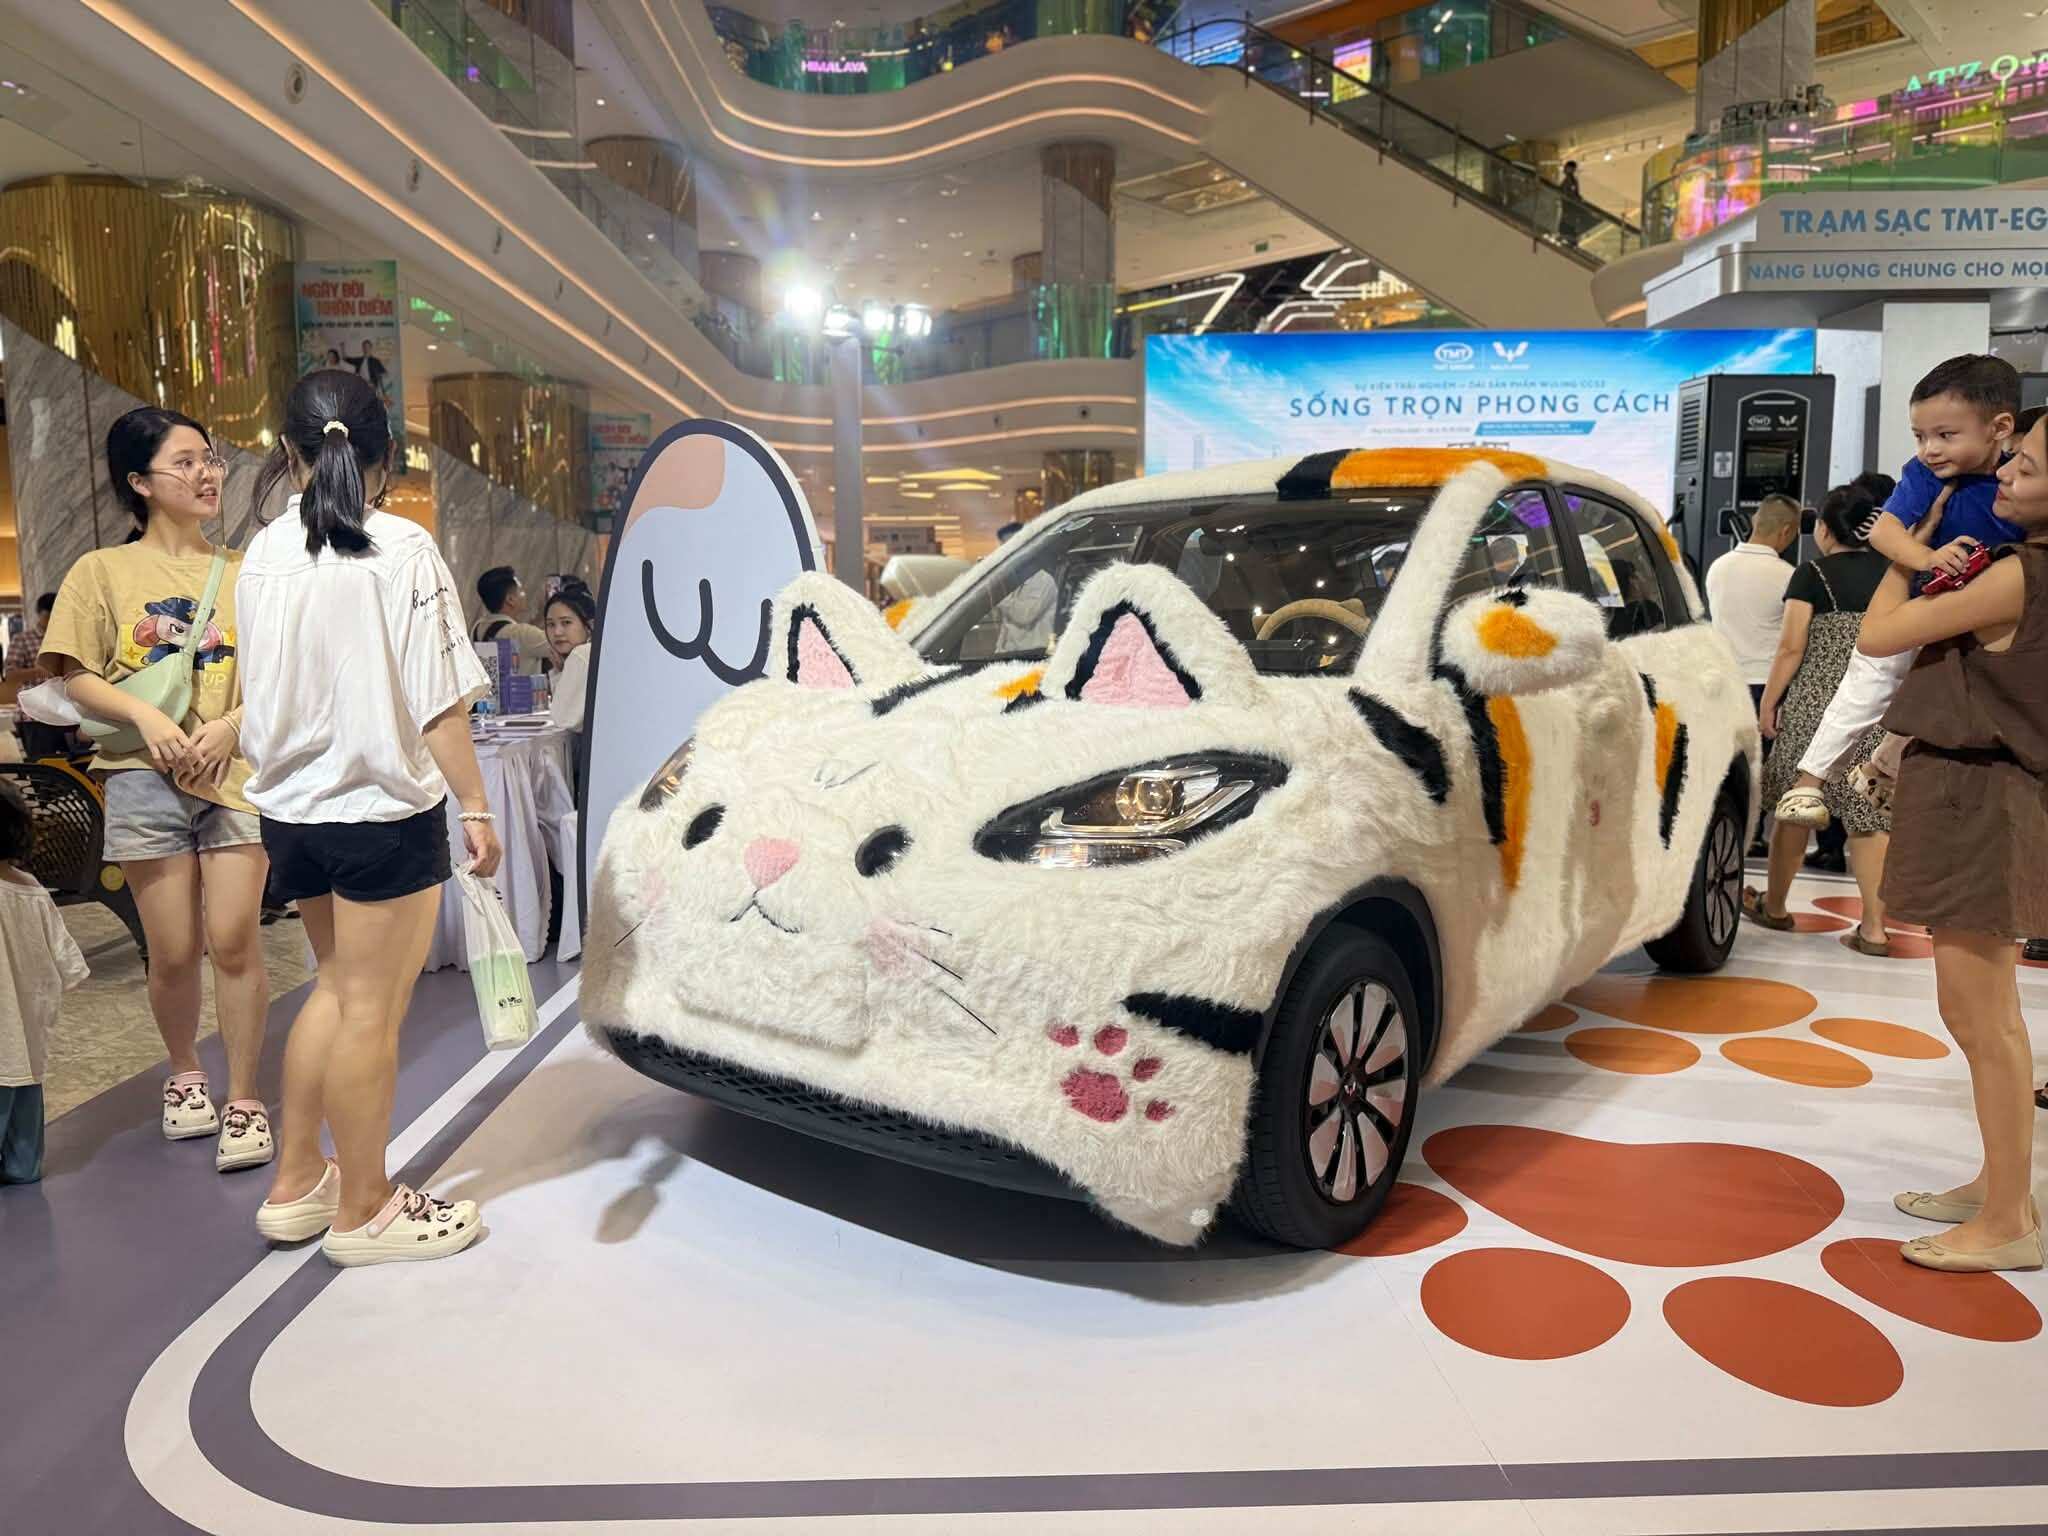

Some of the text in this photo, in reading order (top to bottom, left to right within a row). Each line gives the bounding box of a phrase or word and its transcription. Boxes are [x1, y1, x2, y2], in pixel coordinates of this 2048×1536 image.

[801, 61, 868, 73] HIMALAYA
[1779, 208, 1867, 238] TRẠM
[1875, 207, 1931, 237] SẠC
[1888, 263, 1957, 278] CHUNG
[1964, 262, 2005, 277] CHO
[1290, 389, 1669, 419] SỐNG TRỌN PHONG CÁCH
